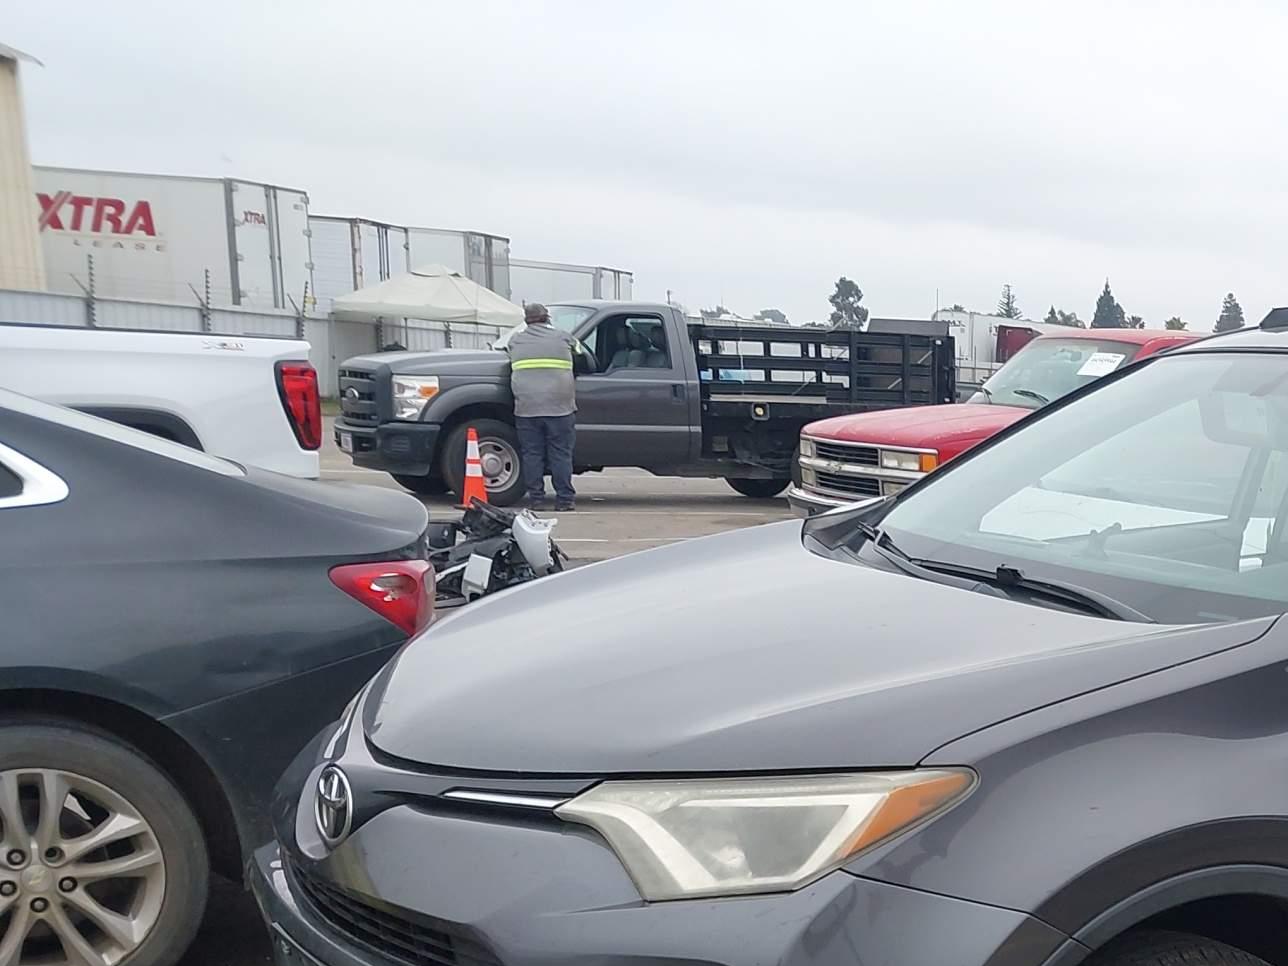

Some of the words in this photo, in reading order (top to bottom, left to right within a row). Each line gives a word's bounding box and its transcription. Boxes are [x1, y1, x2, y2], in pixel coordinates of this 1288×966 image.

[35, 190, 156, 237] XTRA
[243, 210, 266, 225] XTRA
[73, 239, 165, 252] LEASE
